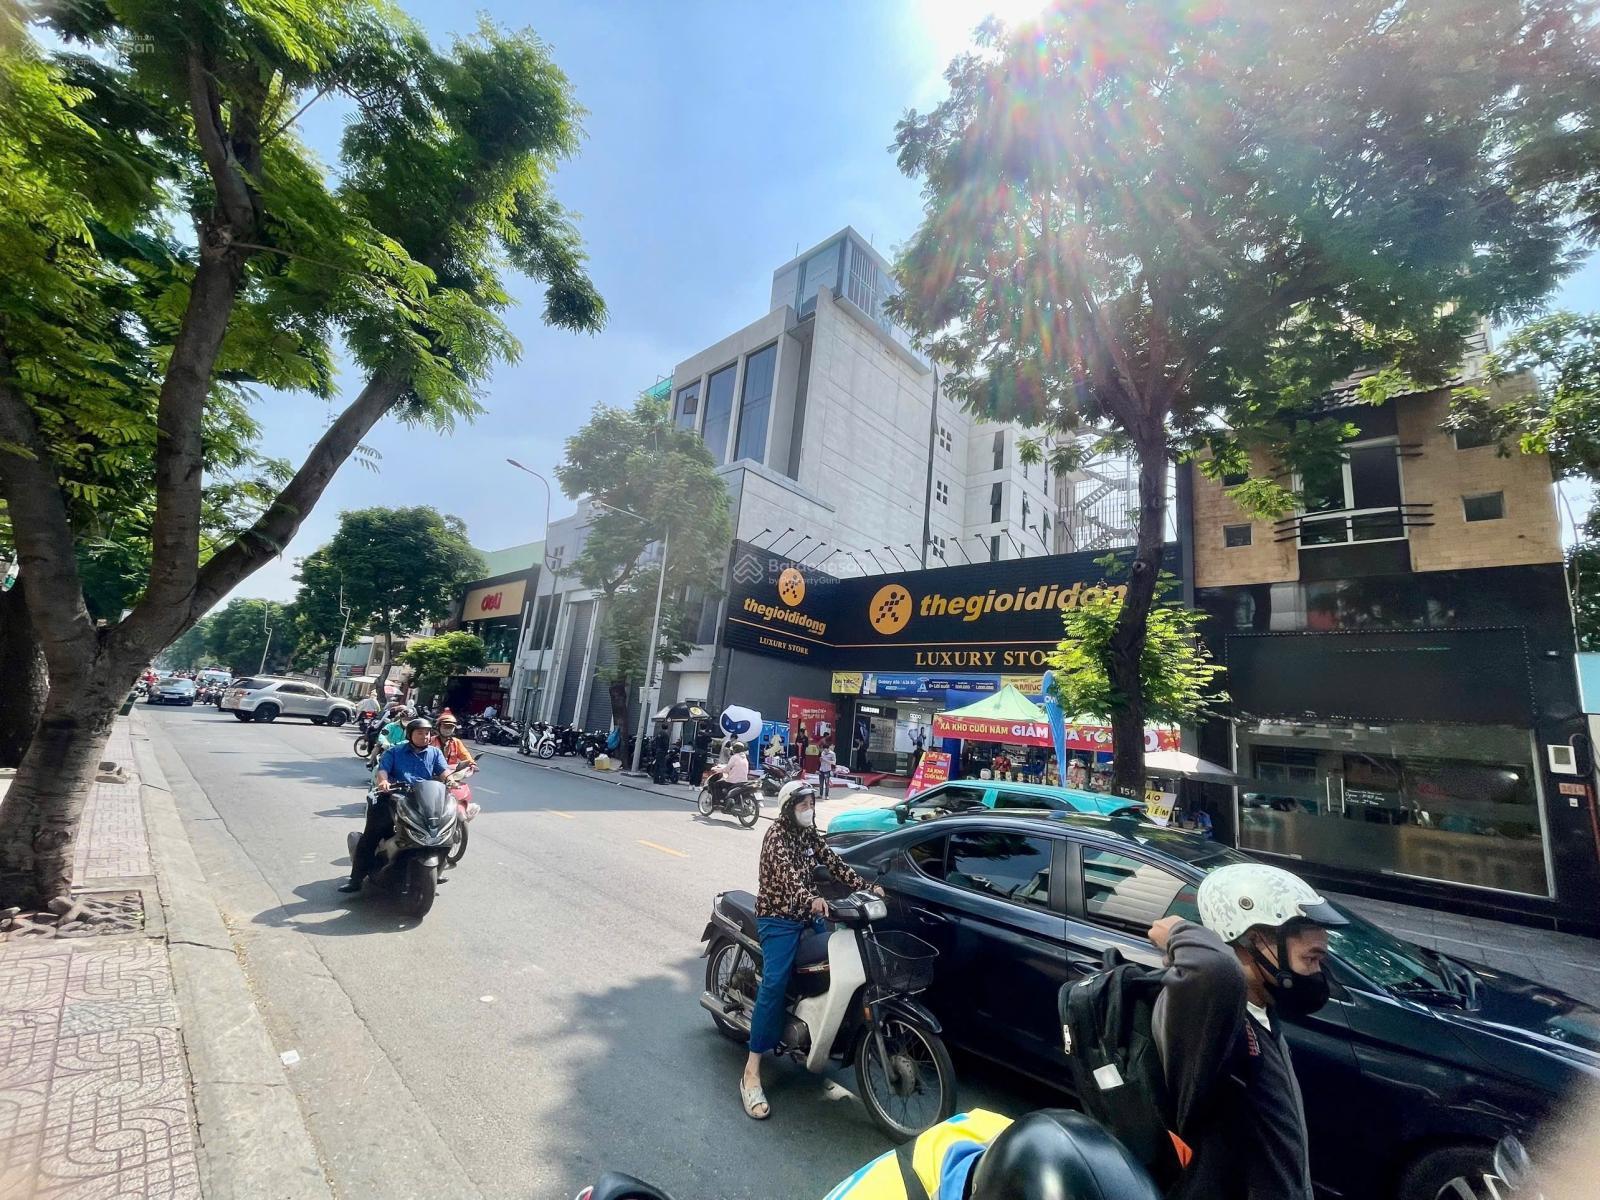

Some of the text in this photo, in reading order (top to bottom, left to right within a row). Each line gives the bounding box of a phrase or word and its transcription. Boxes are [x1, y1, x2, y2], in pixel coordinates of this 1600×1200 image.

[920, 582, 1128, 622] thegioididon
[743, 597, 827, 636] thegioididong
[759, 636, 809, 655] LUXURY STORE
[915, 650, 1053, 667] LUXURY STO
[952, 723, 968, 732] KHO
[1011, 723, 1049, 739] GIẢM
